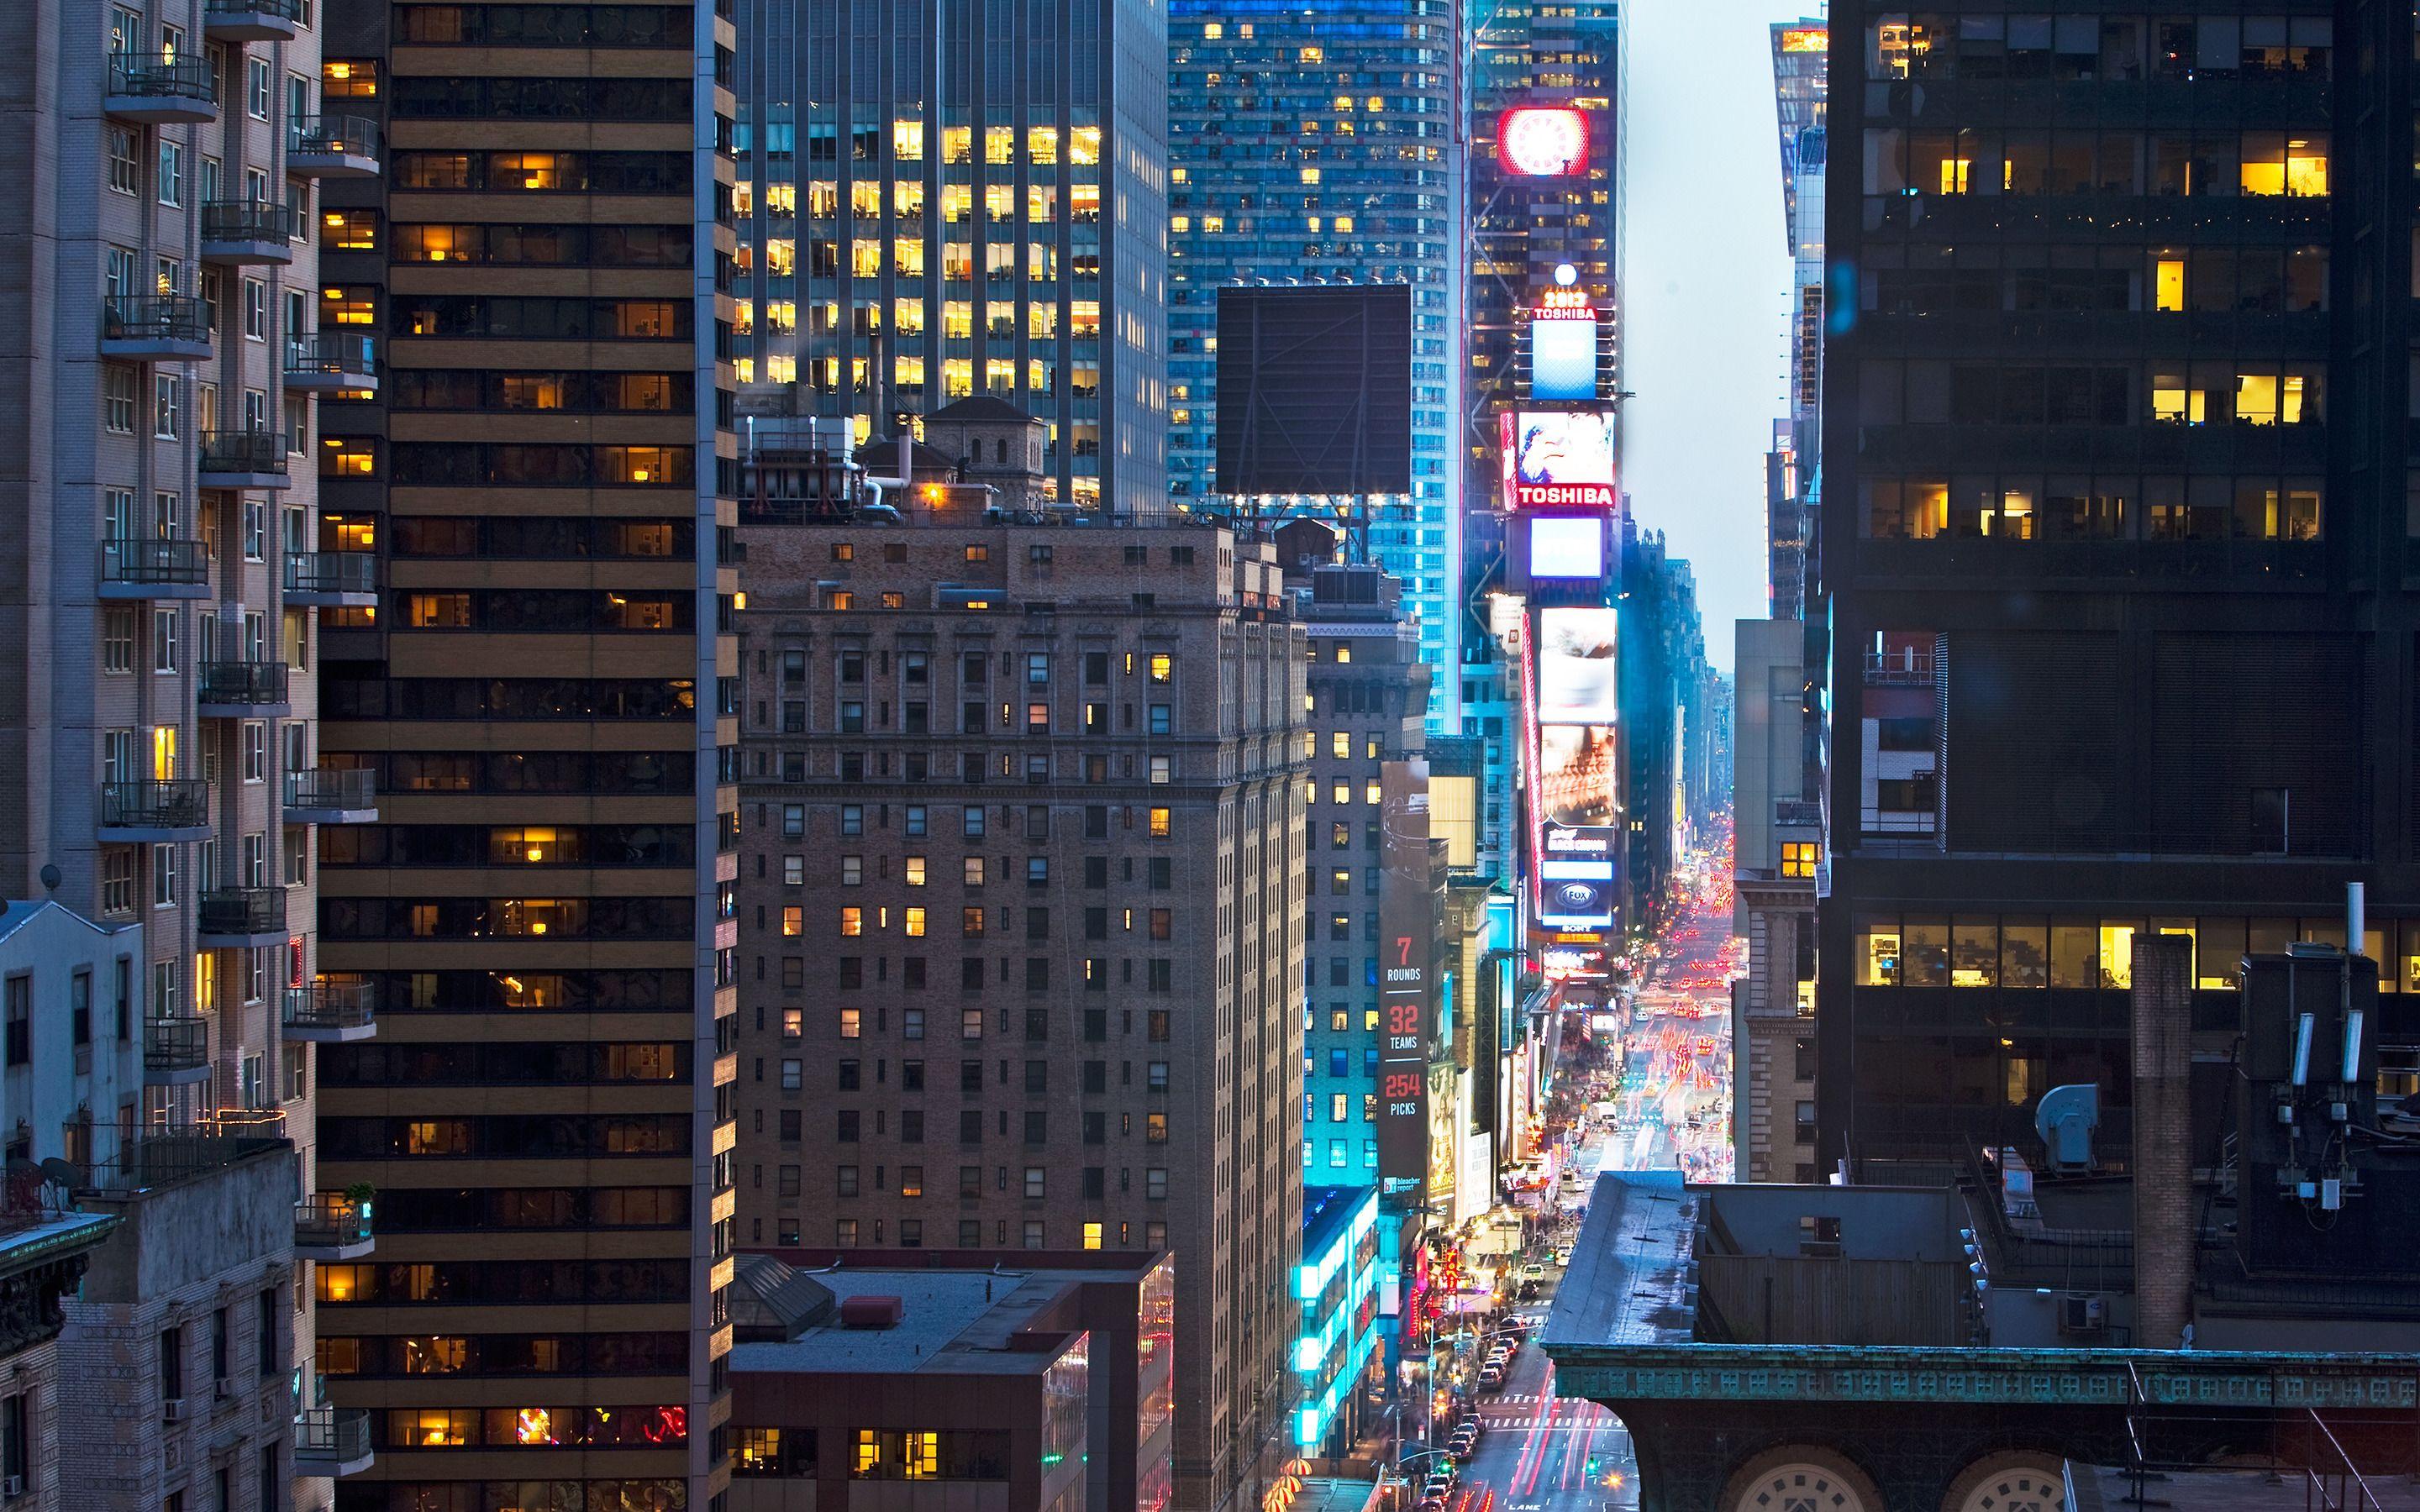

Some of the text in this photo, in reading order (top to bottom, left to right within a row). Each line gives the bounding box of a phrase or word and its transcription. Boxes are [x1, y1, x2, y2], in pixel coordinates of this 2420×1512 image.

[1534, 308, 1596, 319] TOSHIBA
[1519, 488, 1613, 504] TOSHIBA
[1569, 891, 1586, 900] FOX
[1397, 937, 1412, 965] 7
[1387, 968, 1421, 981] ROUNDS
[1390, 1005, 1418, 1033] 32
[1390, 1037, 1418, 1049] TEAMS
[1386, 1074, 1421, 1097] 254
[1391, 1102, 1416, 1116] PICKS
